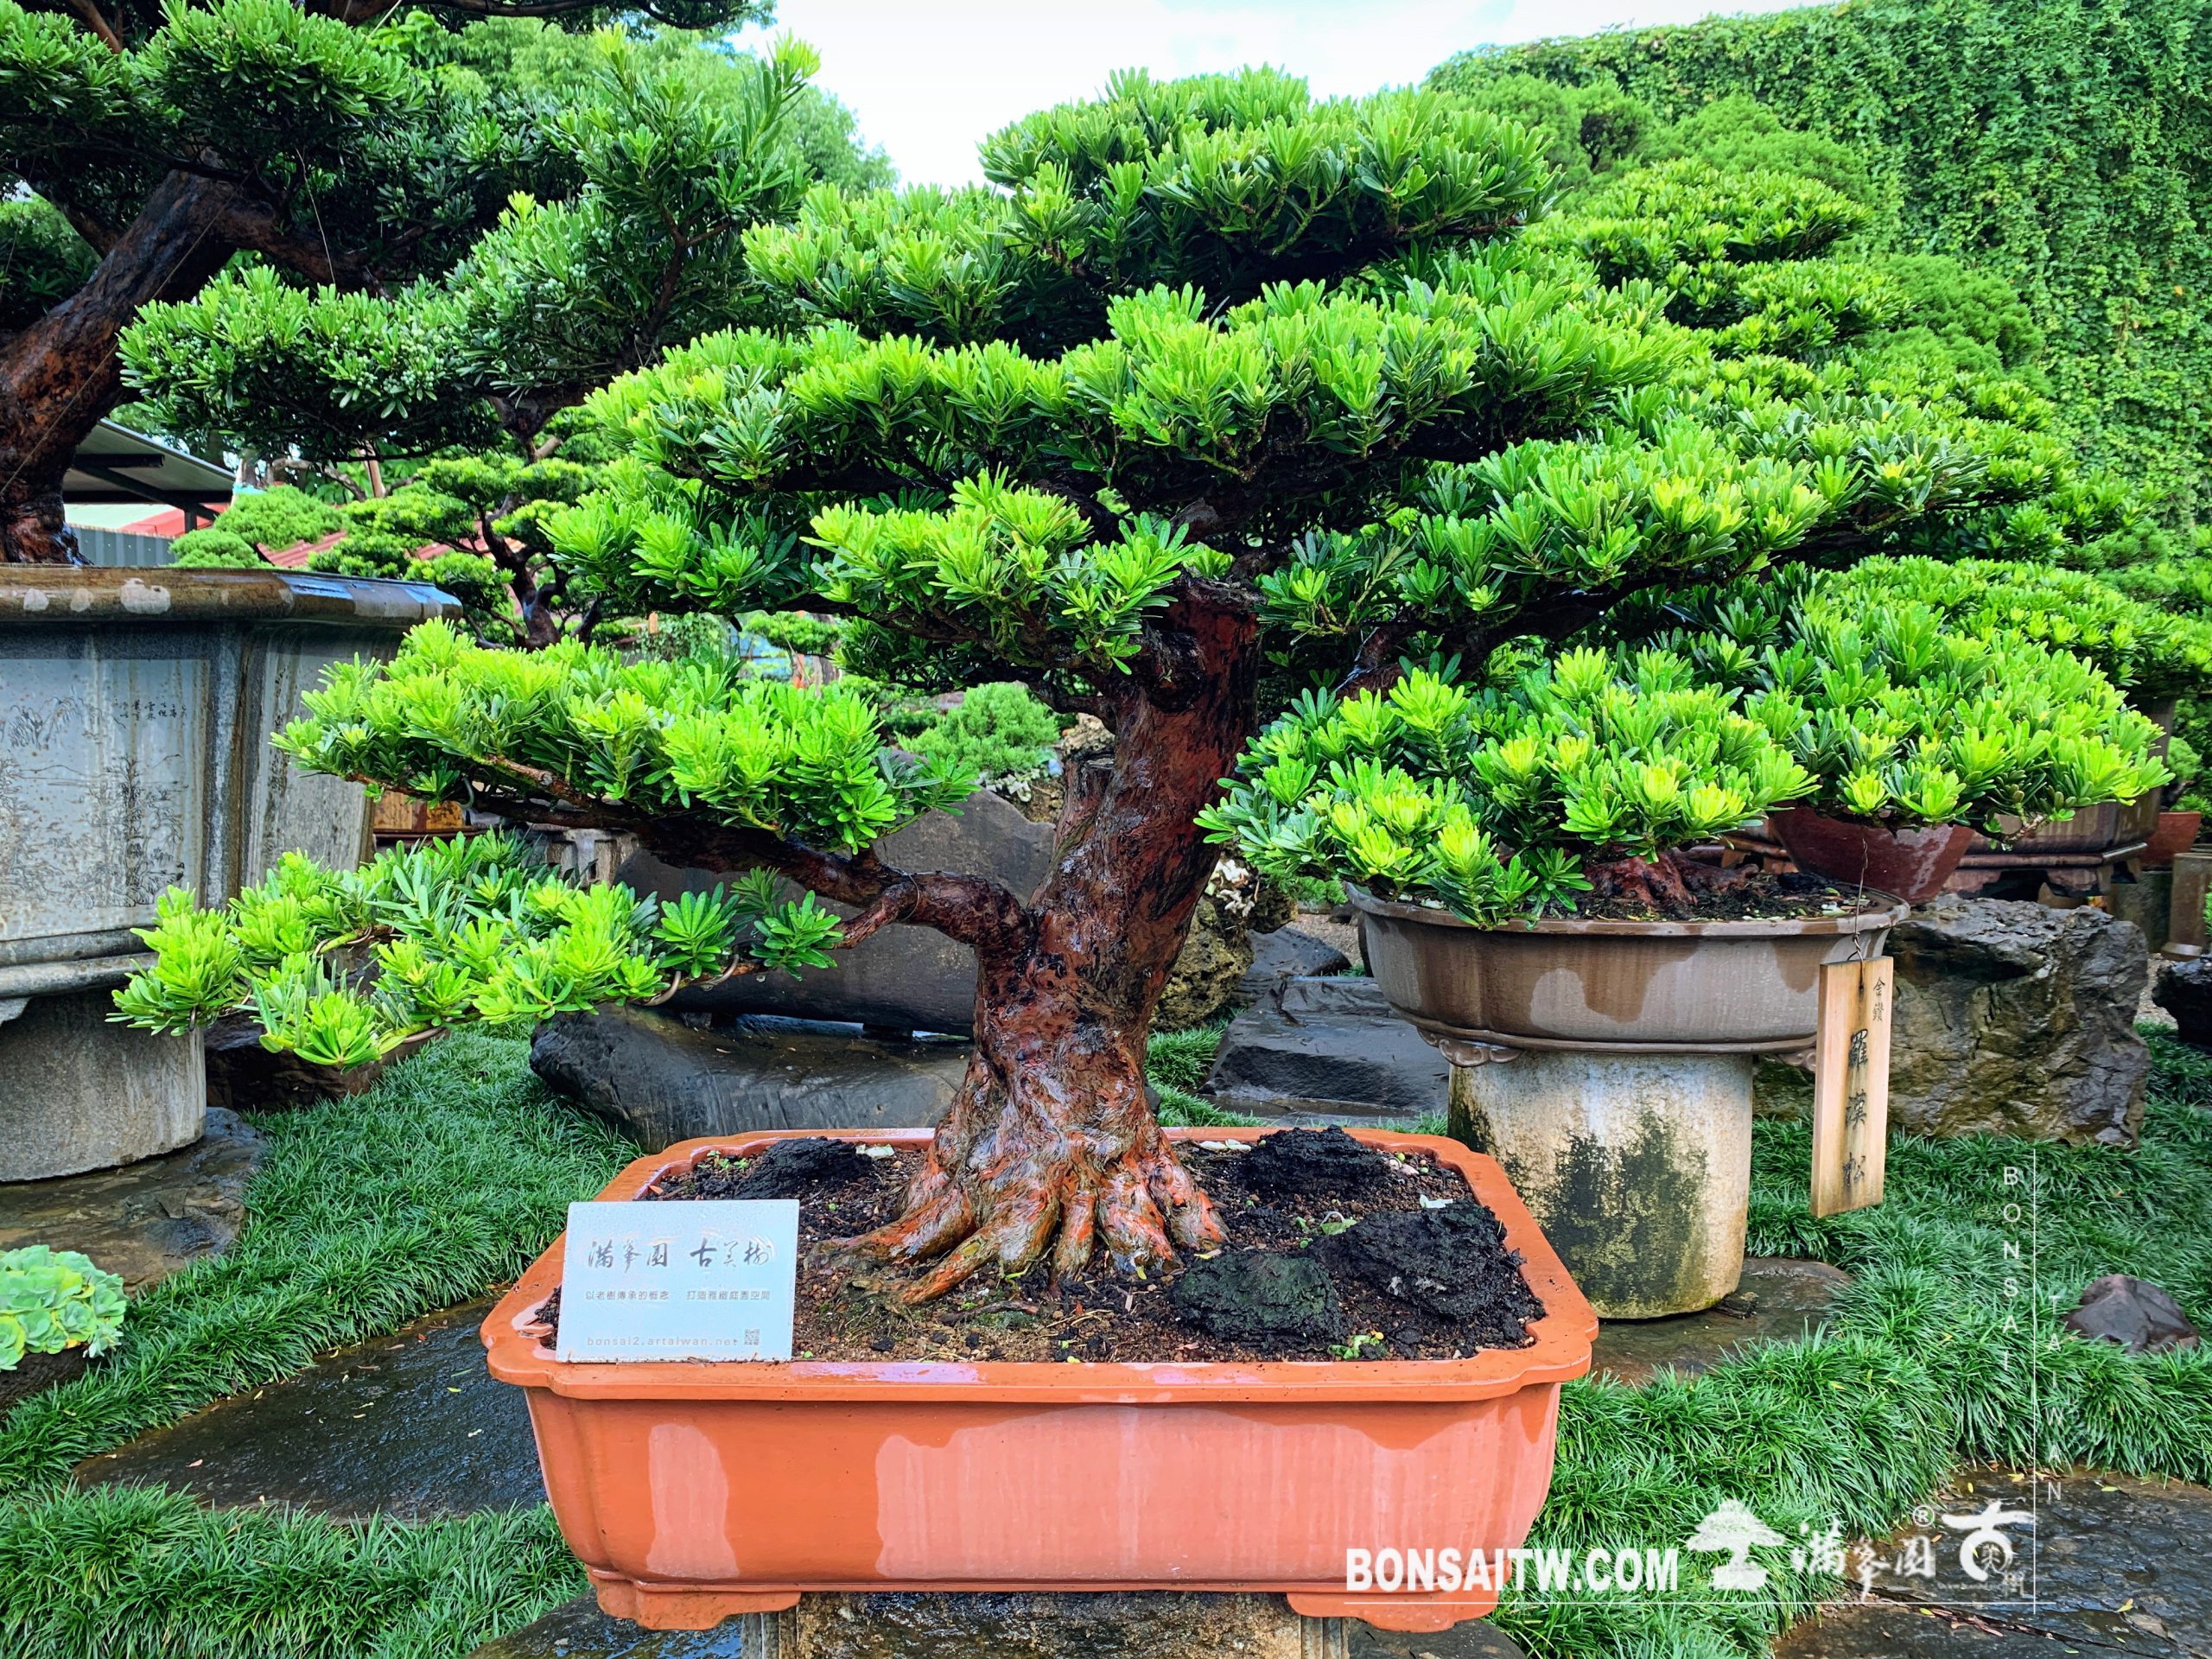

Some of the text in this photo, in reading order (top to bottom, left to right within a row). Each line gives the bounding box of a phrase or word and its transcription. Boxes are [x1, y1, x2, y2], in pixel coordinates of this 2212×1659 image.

[1842, 1028, 1868, 1191] 羅漢松
[587, 1336, 739, 1347] bonsai2.artaiwan.net
